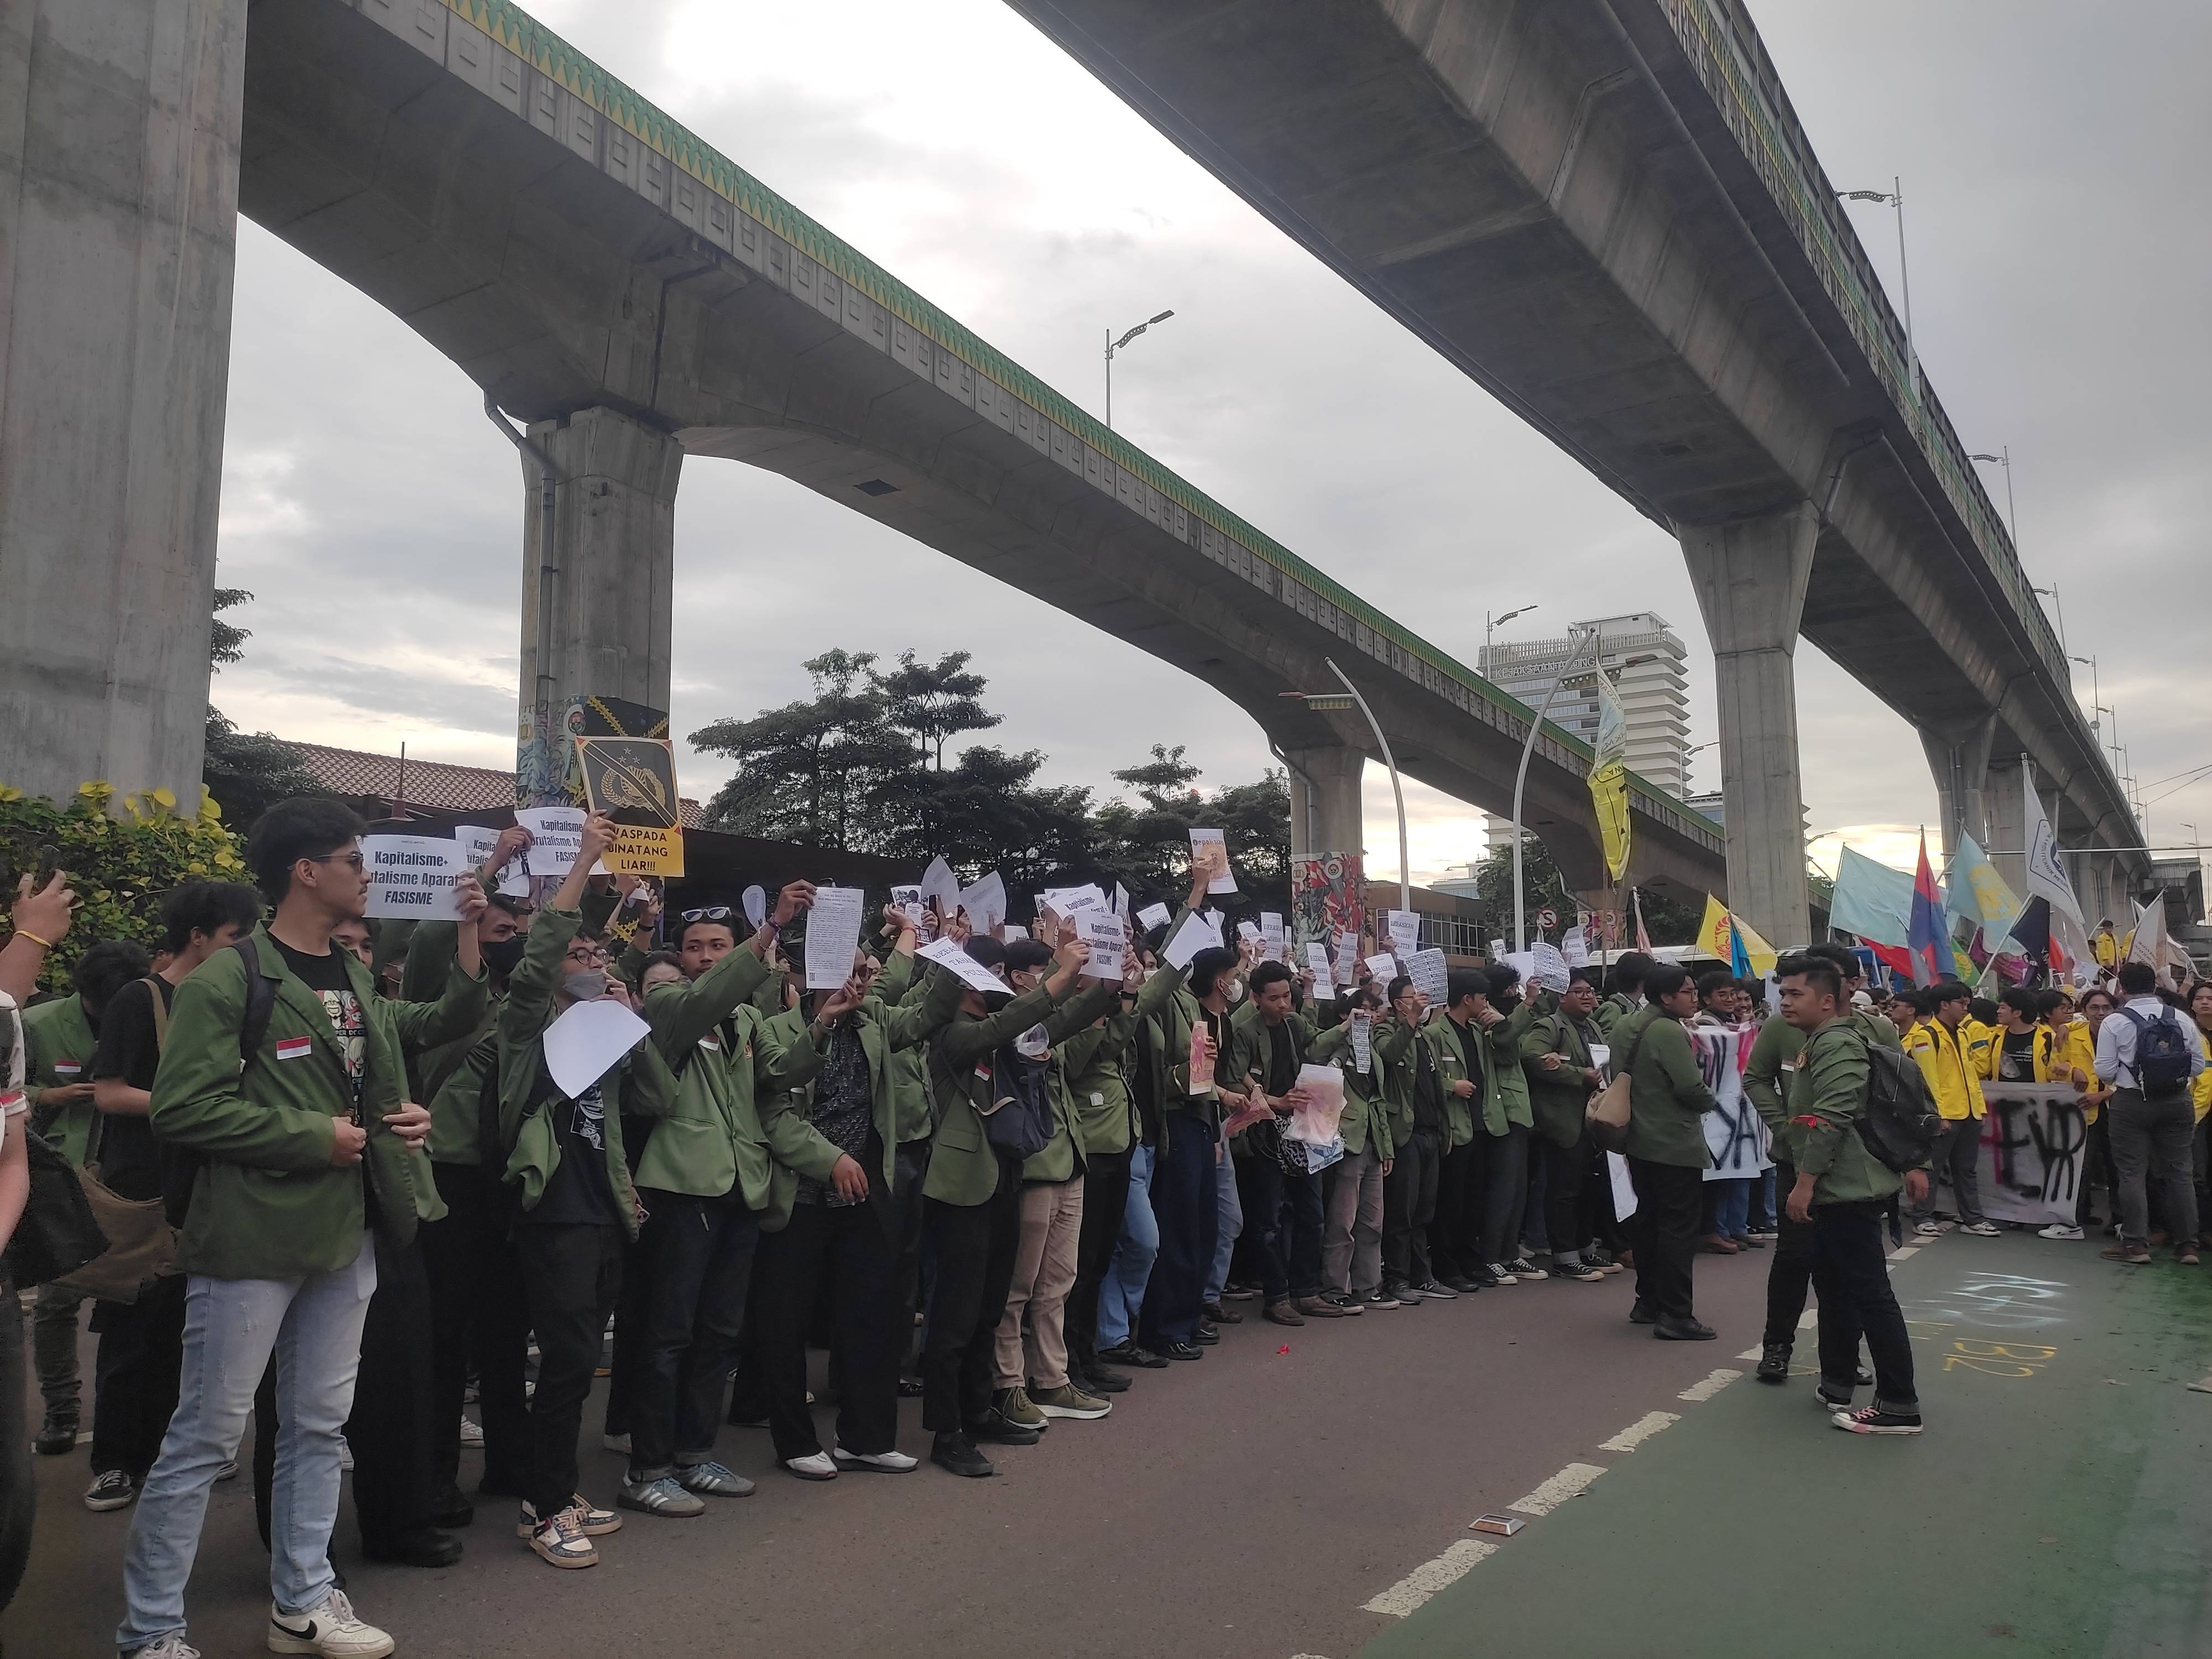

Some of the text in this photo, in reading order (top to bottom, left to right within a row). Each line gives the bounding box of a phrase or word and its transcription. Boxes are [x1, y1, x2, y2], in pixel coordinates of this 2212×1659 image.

[1495, 656, 1596, 679] KEJAKSAAN AUNG
[620, 859, 656, 871] LIAR!!!
[384, 891, 433, 905] FASISME
